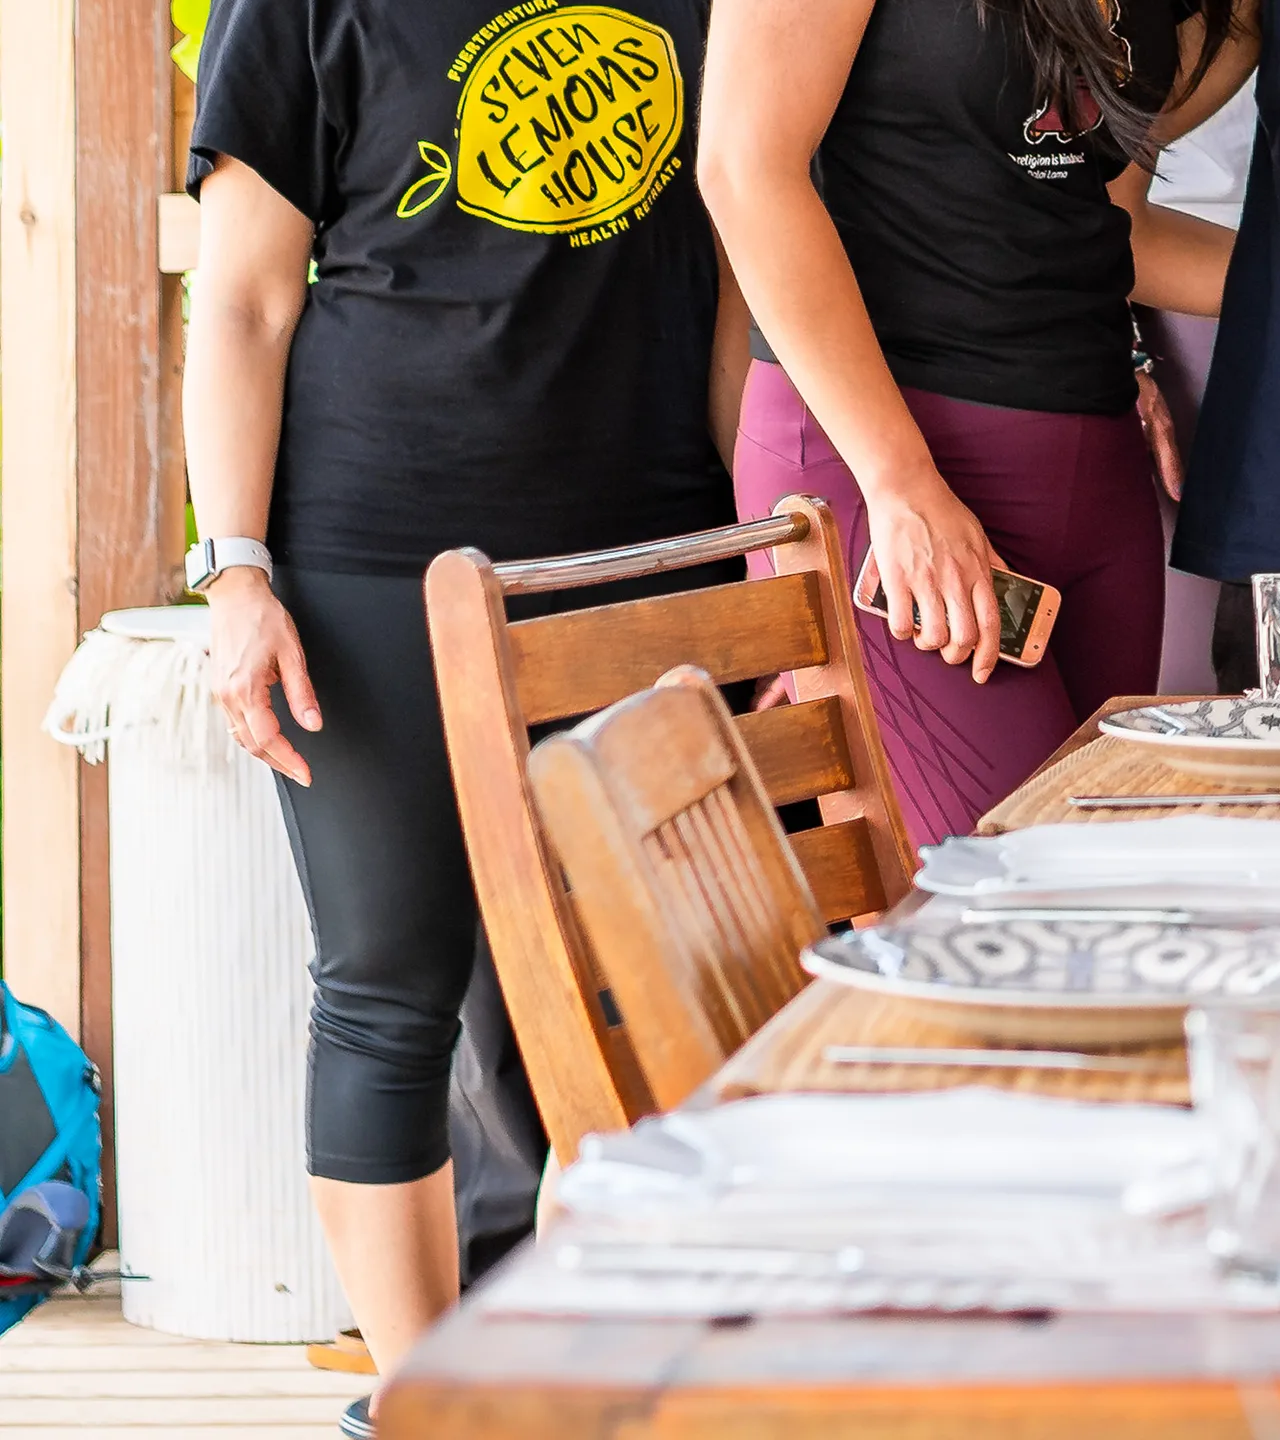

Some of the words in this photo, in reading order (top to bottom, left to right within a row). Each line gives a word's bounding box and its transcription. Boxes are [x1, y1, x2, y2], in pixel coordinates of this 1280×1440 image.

[476, 37, 659, 198] LEMONS
[480, 23, 601, 123] SEVEN
[540, 99, 661, 208] HOUSE
[569, 217, 630, 248] HEALTH
[634, 157, 682, 221] RETREATS
[1016, 154, 1050, 169] religion
[1051, 153, 1059, 166] is
